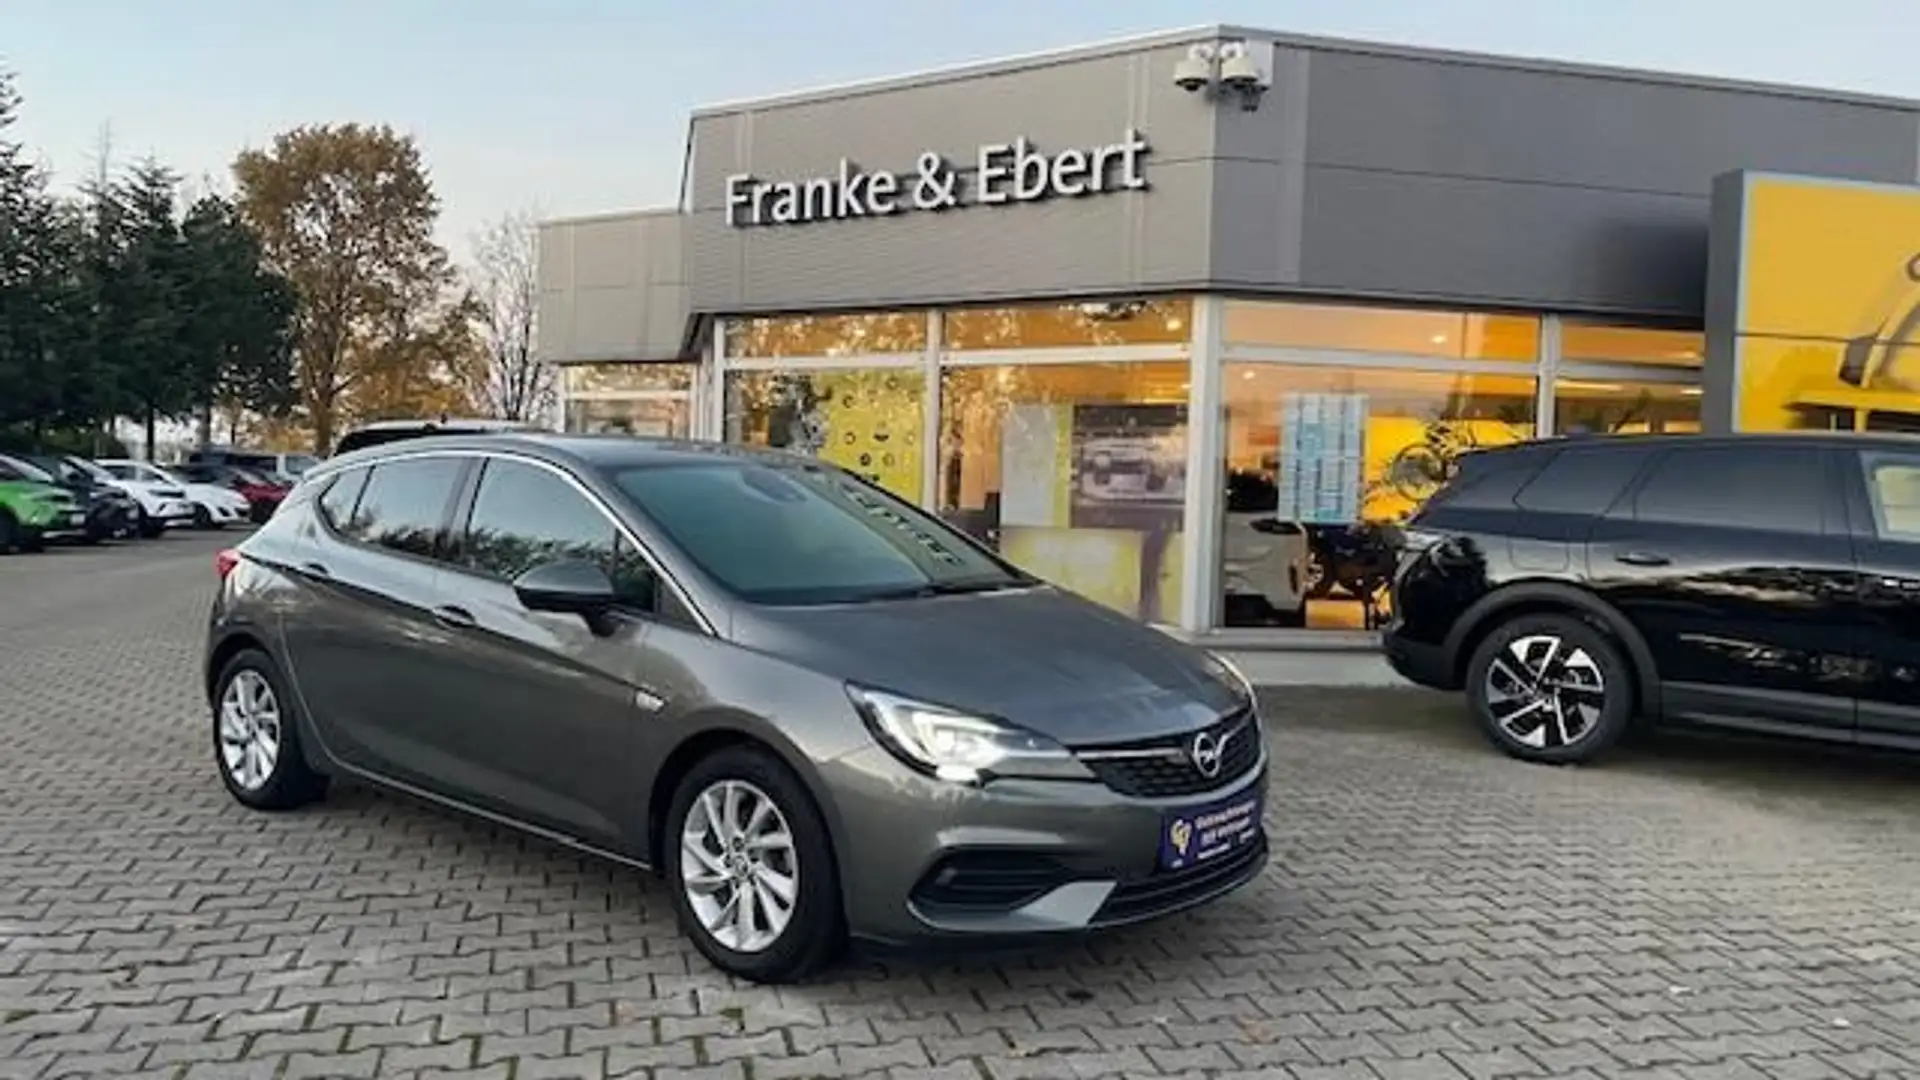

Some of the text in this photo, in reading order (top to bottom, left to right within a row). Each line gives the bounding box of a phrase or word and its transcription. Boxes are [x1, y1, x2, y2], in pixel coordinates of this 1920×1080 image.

[725, 128, 1148, 226] Franke & Ebert
